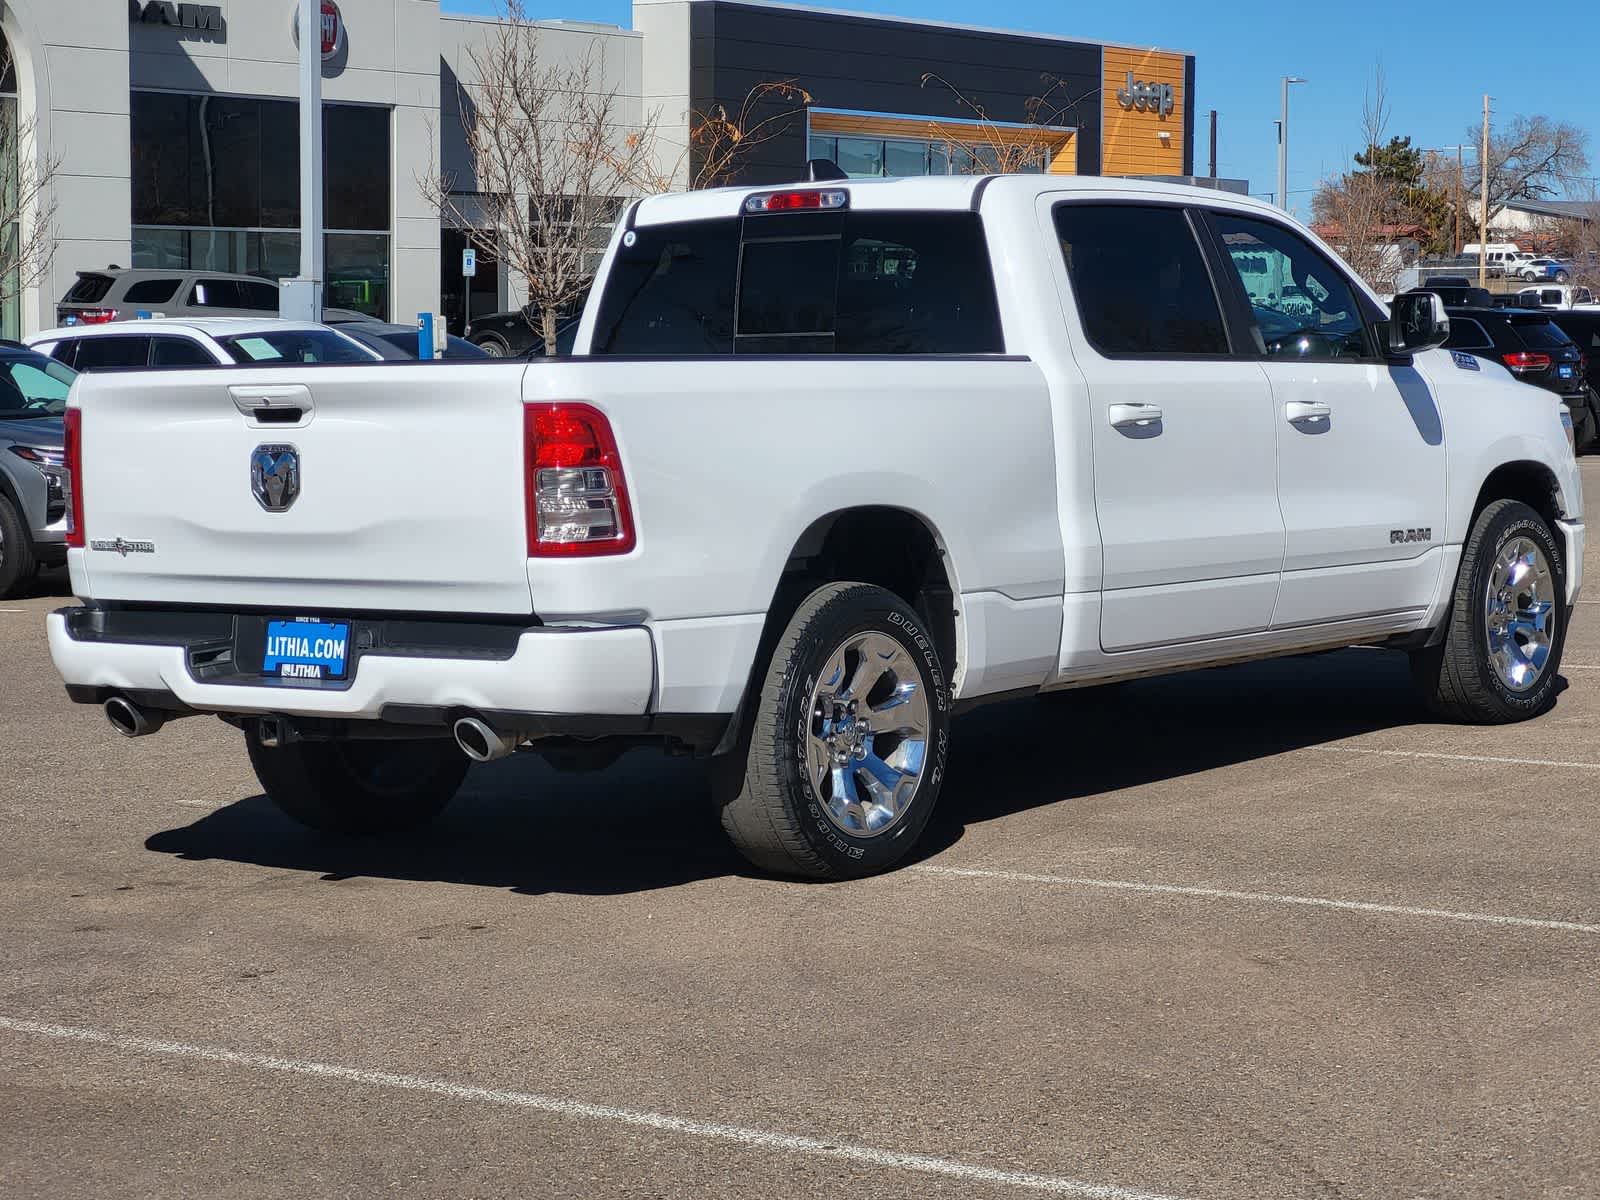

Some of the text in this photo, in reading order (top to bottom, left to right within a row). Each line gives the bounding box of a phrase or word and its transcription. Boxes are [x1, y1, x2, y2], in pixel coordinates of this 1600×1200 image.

[1117, 71, 1174, 120] Jeep
[1390, 528, 1431, 544] RAM
[267, 636, 345, 660] LITHIA.COM
[888, 611, 947, 712] DUELER
[291, 664, 320, 678] LITHIA
[797, 673, 866, 860] BRIDGESTONE
